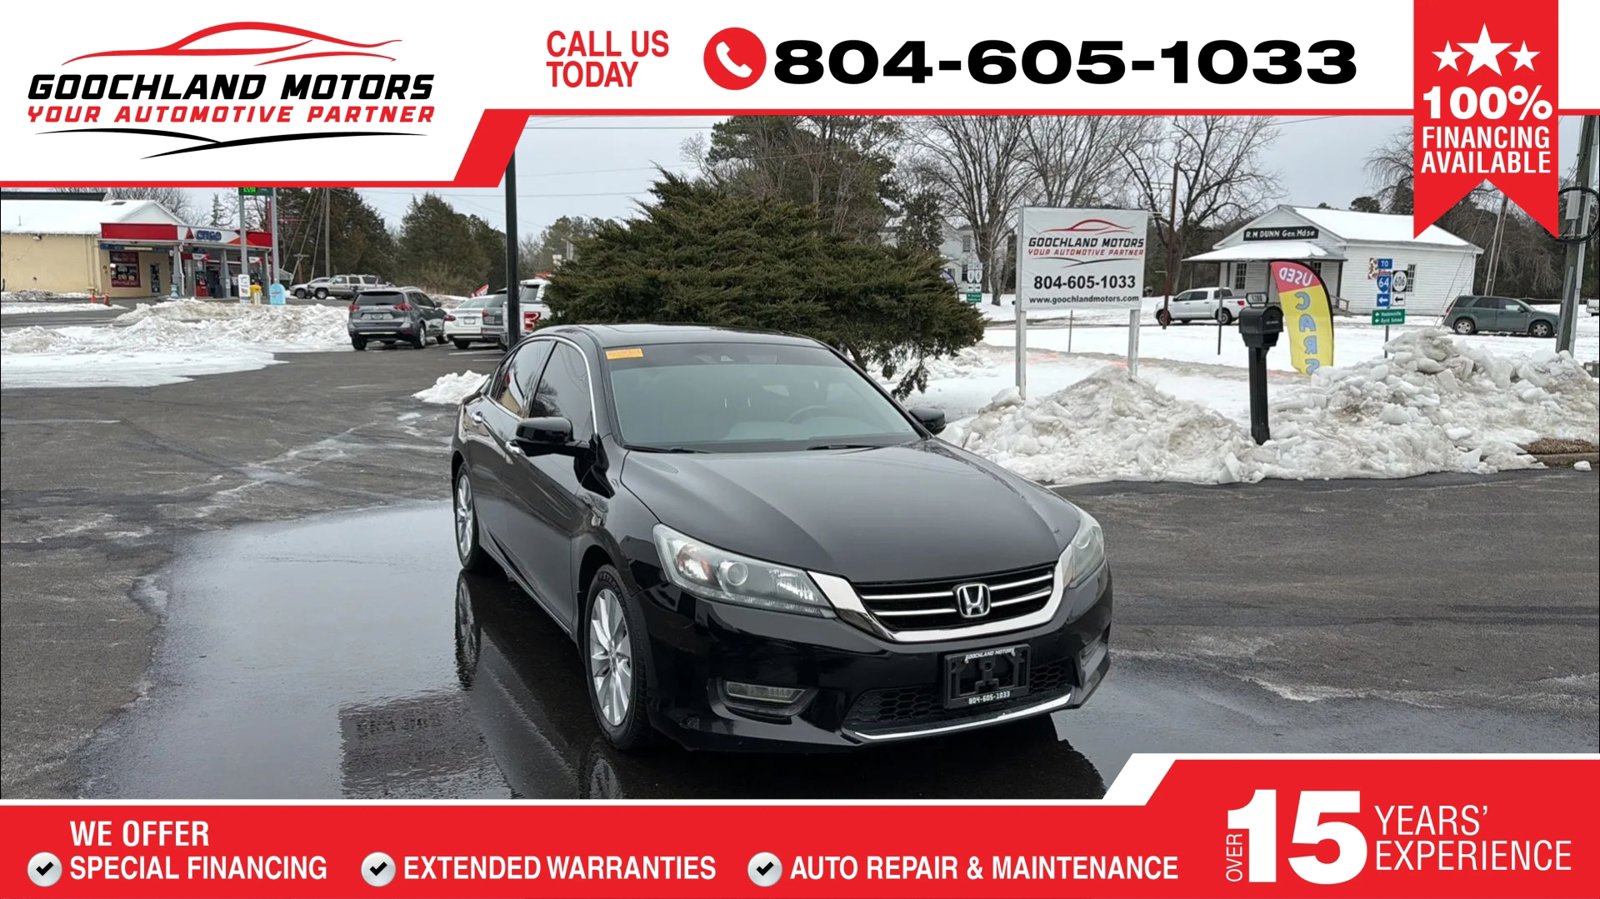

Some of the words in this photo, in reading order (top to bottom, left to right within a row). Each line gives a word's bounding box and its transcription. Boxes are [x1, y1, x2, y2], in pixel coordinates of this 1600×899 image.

[1259, 230, 1280, 238] DUNN
[1028, 237, 1098, 248] GOOCHLAND
[1101, 237, 1144, 248] MOTORS
[1028, 248, 1051, 256] YOUR
[1053, 248, 1105, 256] AUTOMOTIVE
[1108, 248, 1144, 256] PARTNER
[1033, 275, 1136, 290] 804-605-1033
[1378, 277, 1390, 288] 64
[1028, 294, 1139, 305] www.goochlandmotors.com
[968, 690, 1011, 705] 804-605-1033
